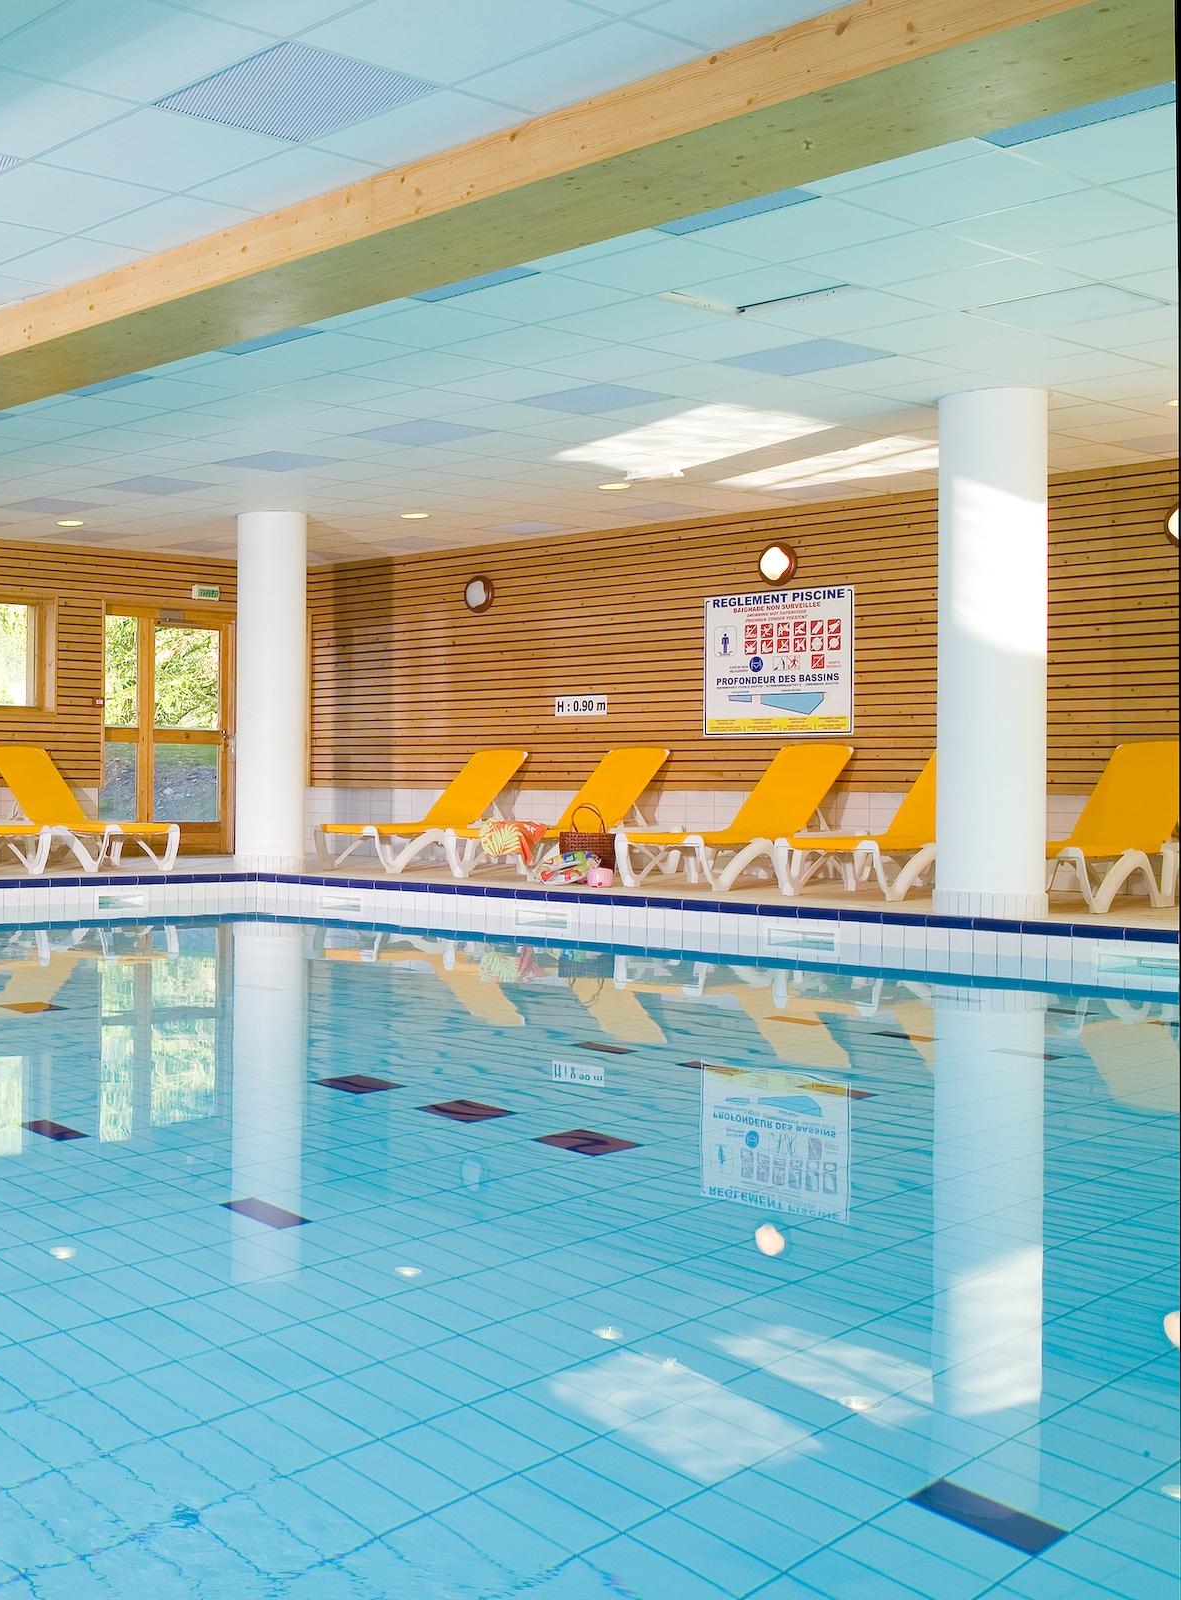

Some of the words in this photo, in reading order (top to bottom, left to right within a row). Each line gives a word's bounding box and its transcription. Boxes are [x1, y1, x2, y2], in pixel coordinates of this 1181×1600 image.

[713, 593, 788, 608] REGLEMENT
[792, 588, 845, 602] PISCINE
[733, 605, 766, 613] BAIGNADE
[781, 601, 821, 610] SURVEILLEE
[716, 675, 776, 686] PROFONDEUR
[778, 674, 796, 683] DES
[799, 672, 840, 682] BASSINS
[557, 701, 564, 713] H
[573, 700, 594, 712] 0.90
[596, 701, 606, 711] m
